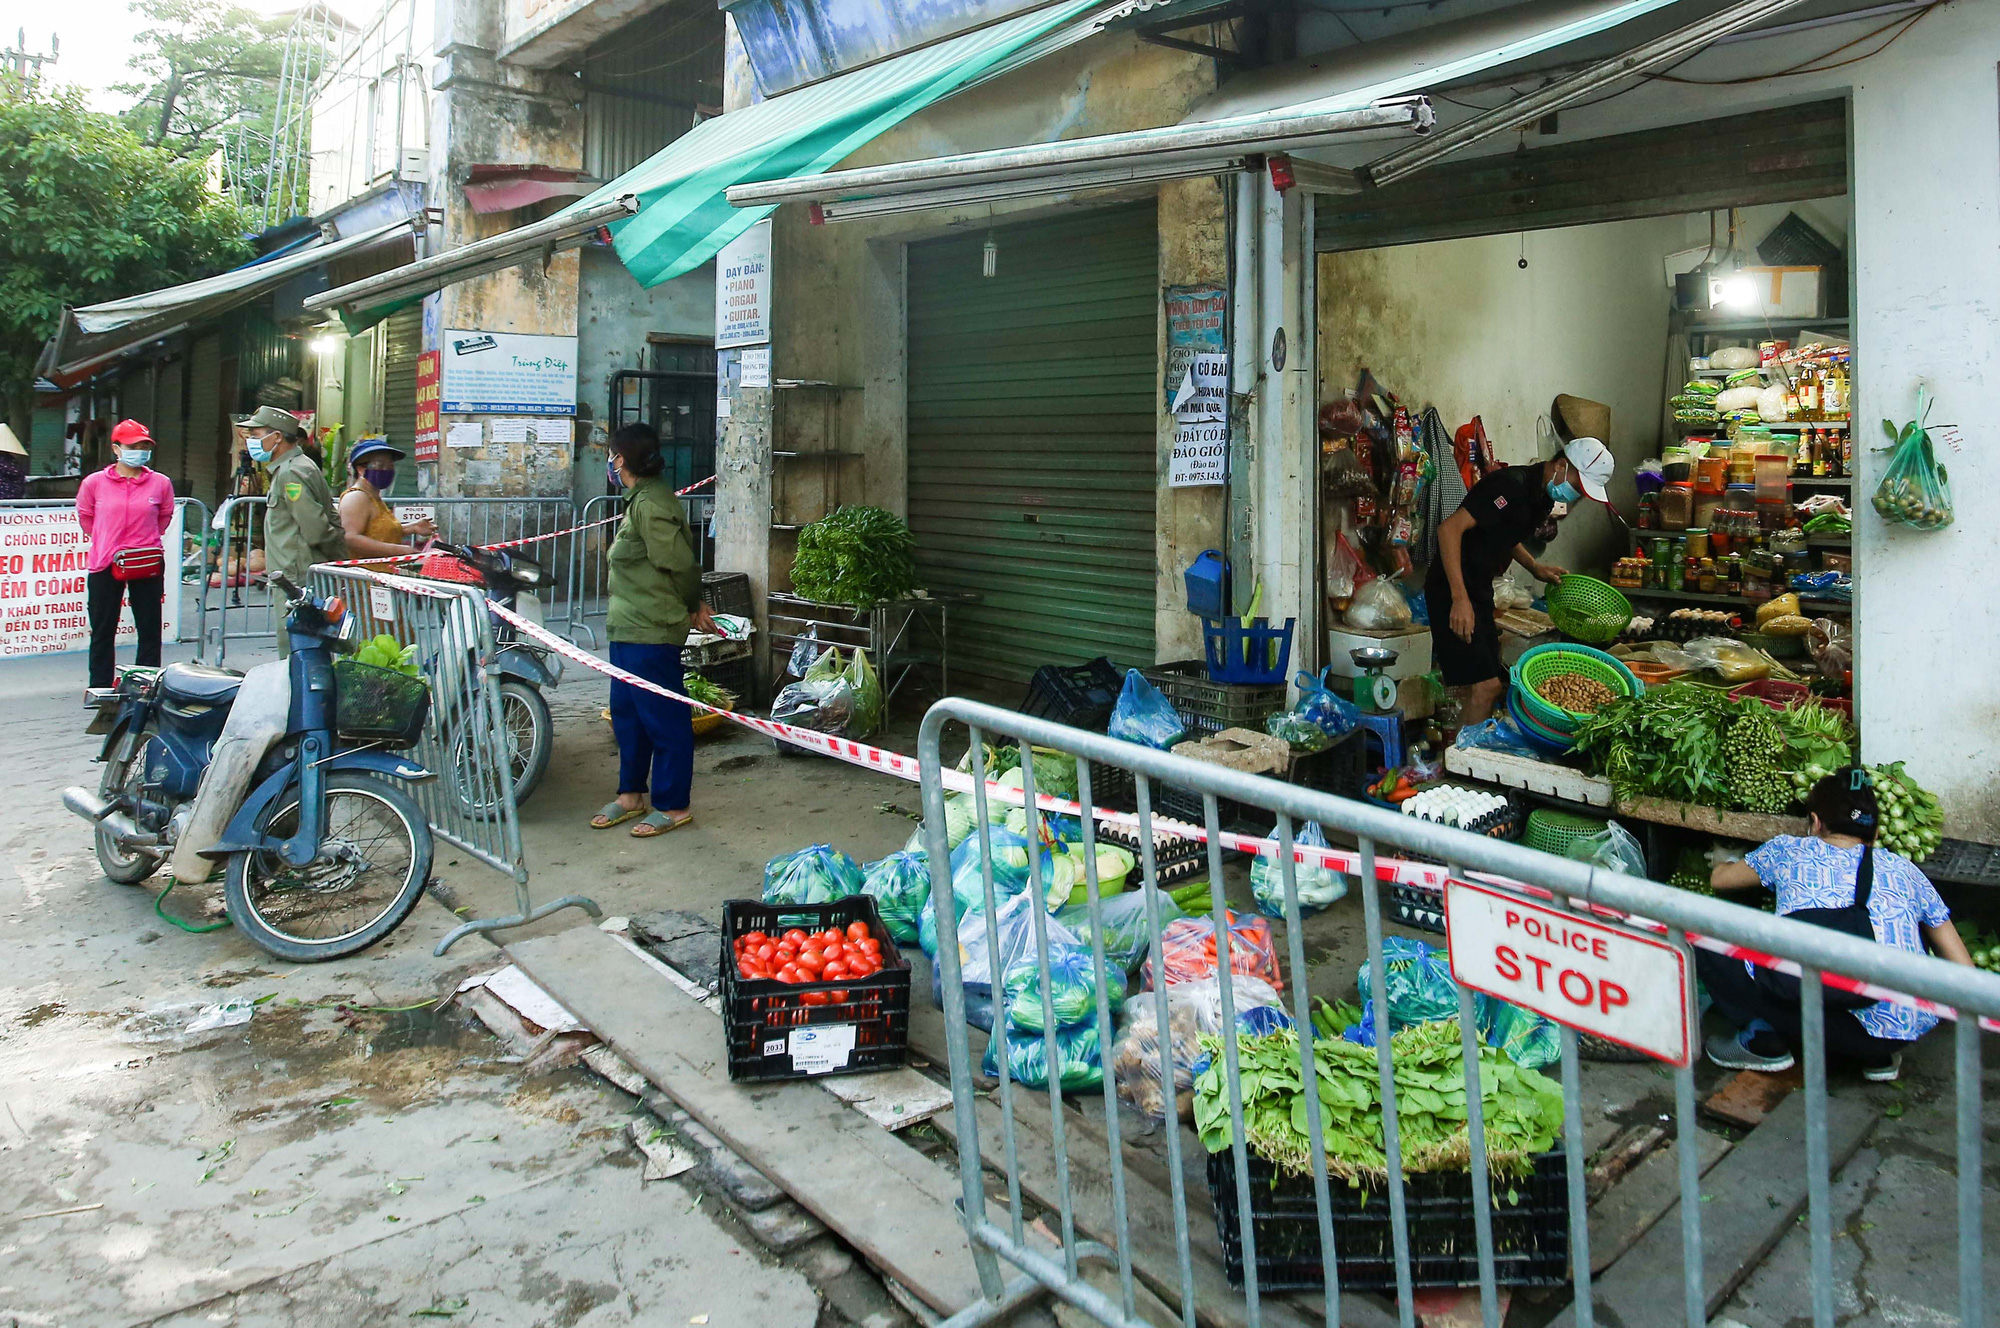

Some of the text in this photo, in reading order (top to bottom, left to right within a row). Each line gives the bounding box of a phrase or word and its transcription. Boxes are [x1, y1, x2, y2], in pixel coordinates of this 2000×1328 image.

[726, 262, 764, 279] DẠY ĐÀN:
[729, 279, 755, 292] PIANO
[729, 293, 757, 307] ORGAN
[729, 308, 760, 322] GUITAR.
[1173, 349, 1190, 358] CHO
[512, 356, 568, 371] Trùng Điệp
[1198, 359, 1210, 376] CÓ
[1206, 402, 1222, 413] QUE
[1183, 427, 1202, 442] ĐÂY
[1203, 426, 1217, 441] CÓ
[1173, 442, 1226, 458] ĐÀO GIỐ
[1190, 460, 1219, 469] (Đào ta)
[1175, 473, 1187, 482] ĐT:
[0, 513, 44, 525] ƯỜNG
[4, 530, 46, 546] CHỐNG
[51, 532, 78, 547] DỊCH
[32, 546, 89, 573] KHẨU
[35, 576, 85, 596] CÔNG
[8, 602, 83, 618] KHẨU TRANG
[5, 615, 86, 632] ĐẾN 03 TRIỆU
[16, 635, 27, 643] 12
[31, 633, 57, 644] Nghị
[61, 631, 84, 641] định
[42, 642, 67, 653] phủ)
[1505, 910, 1609, 960] POLICE
[1495, 945, 1629, 1015] STOP
[765, 1043, 783, 1052] 2033
